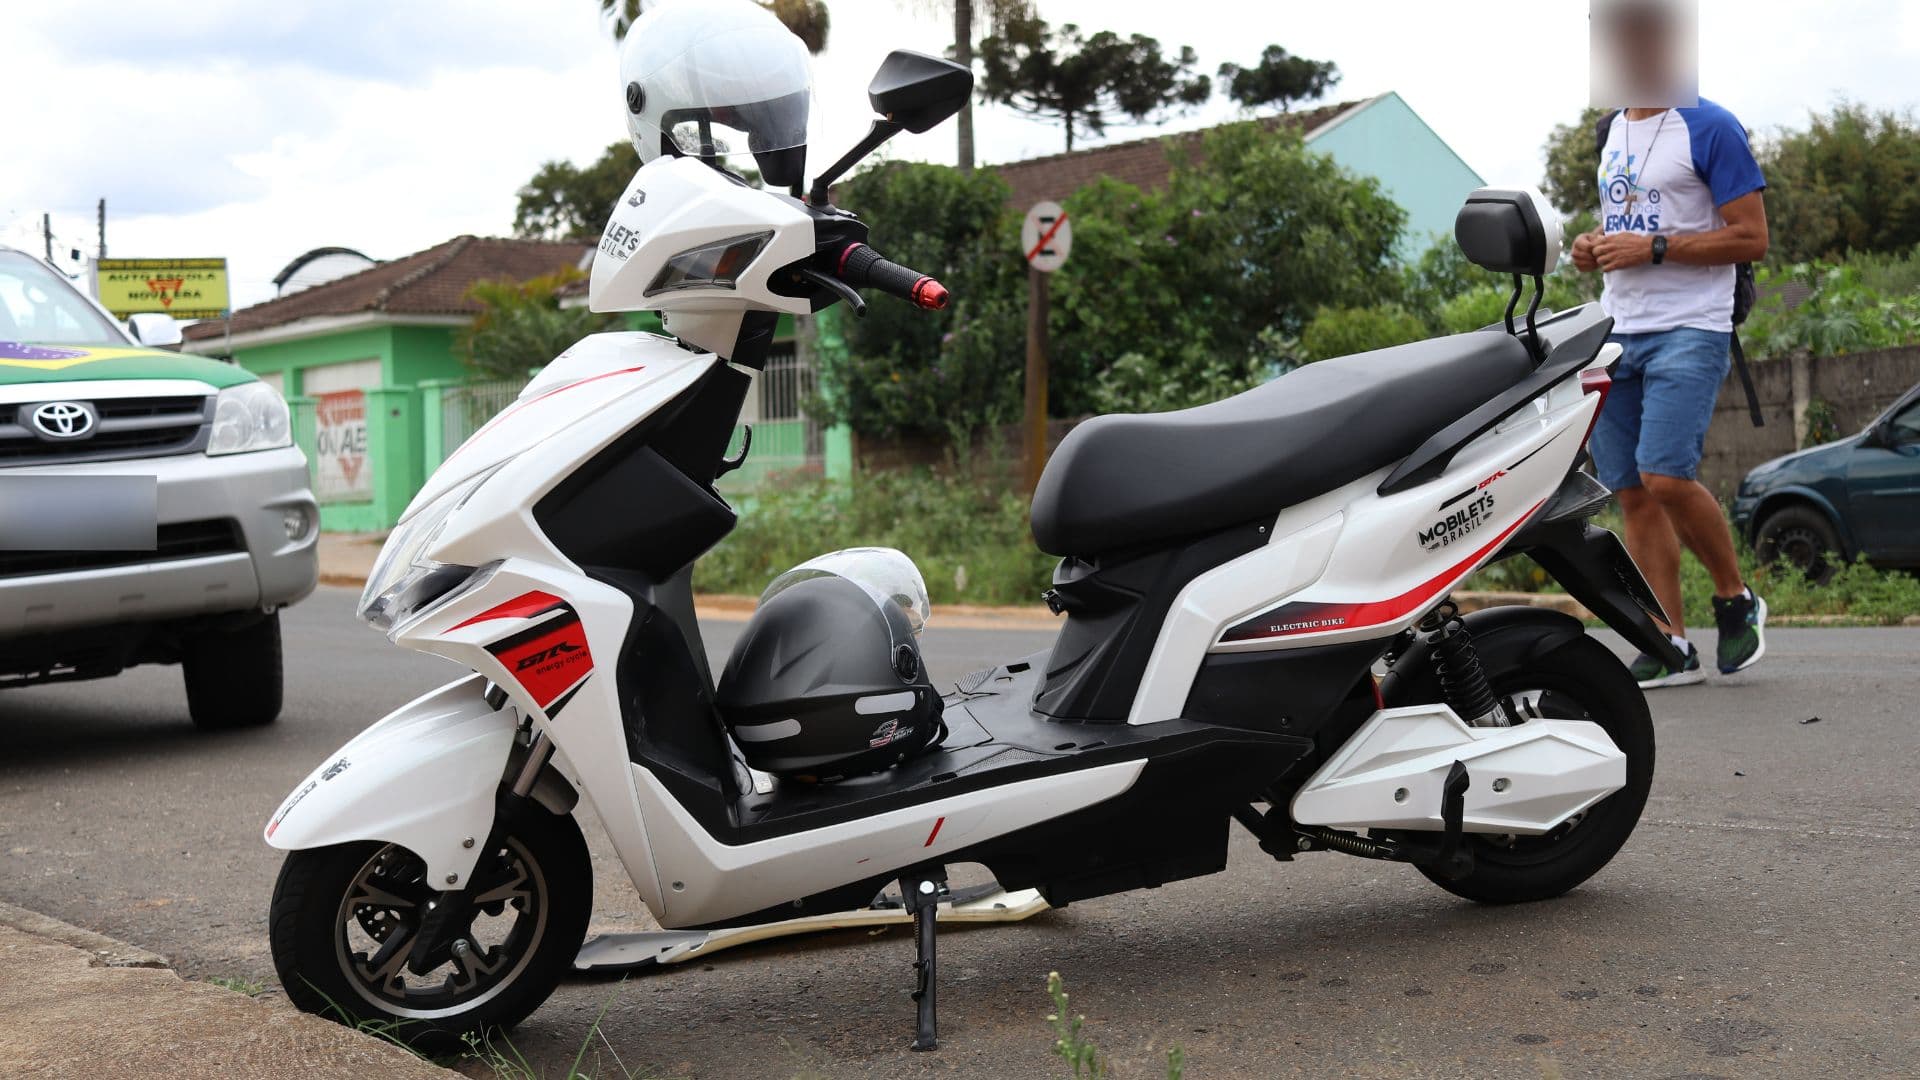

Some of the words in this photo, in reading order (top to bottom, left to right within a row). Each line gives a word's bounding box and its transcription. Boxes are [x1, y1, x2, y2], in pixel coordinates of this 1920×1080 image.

[108, 273, 150, 282] AUTO
[156, 272, 216, 282] ESCOLA
[128, 291, 167, 300] NOVA
[173, 290, 202, 300] ERA
[1442, 517, 1481, 546] BRASIL
[1270, 619, 1320, 633] ELECTRIC
[1321, 617, 1345, 627] BIKE
[536, 659, 565, 675] energy
[565, 650, 587, 664] cycle
